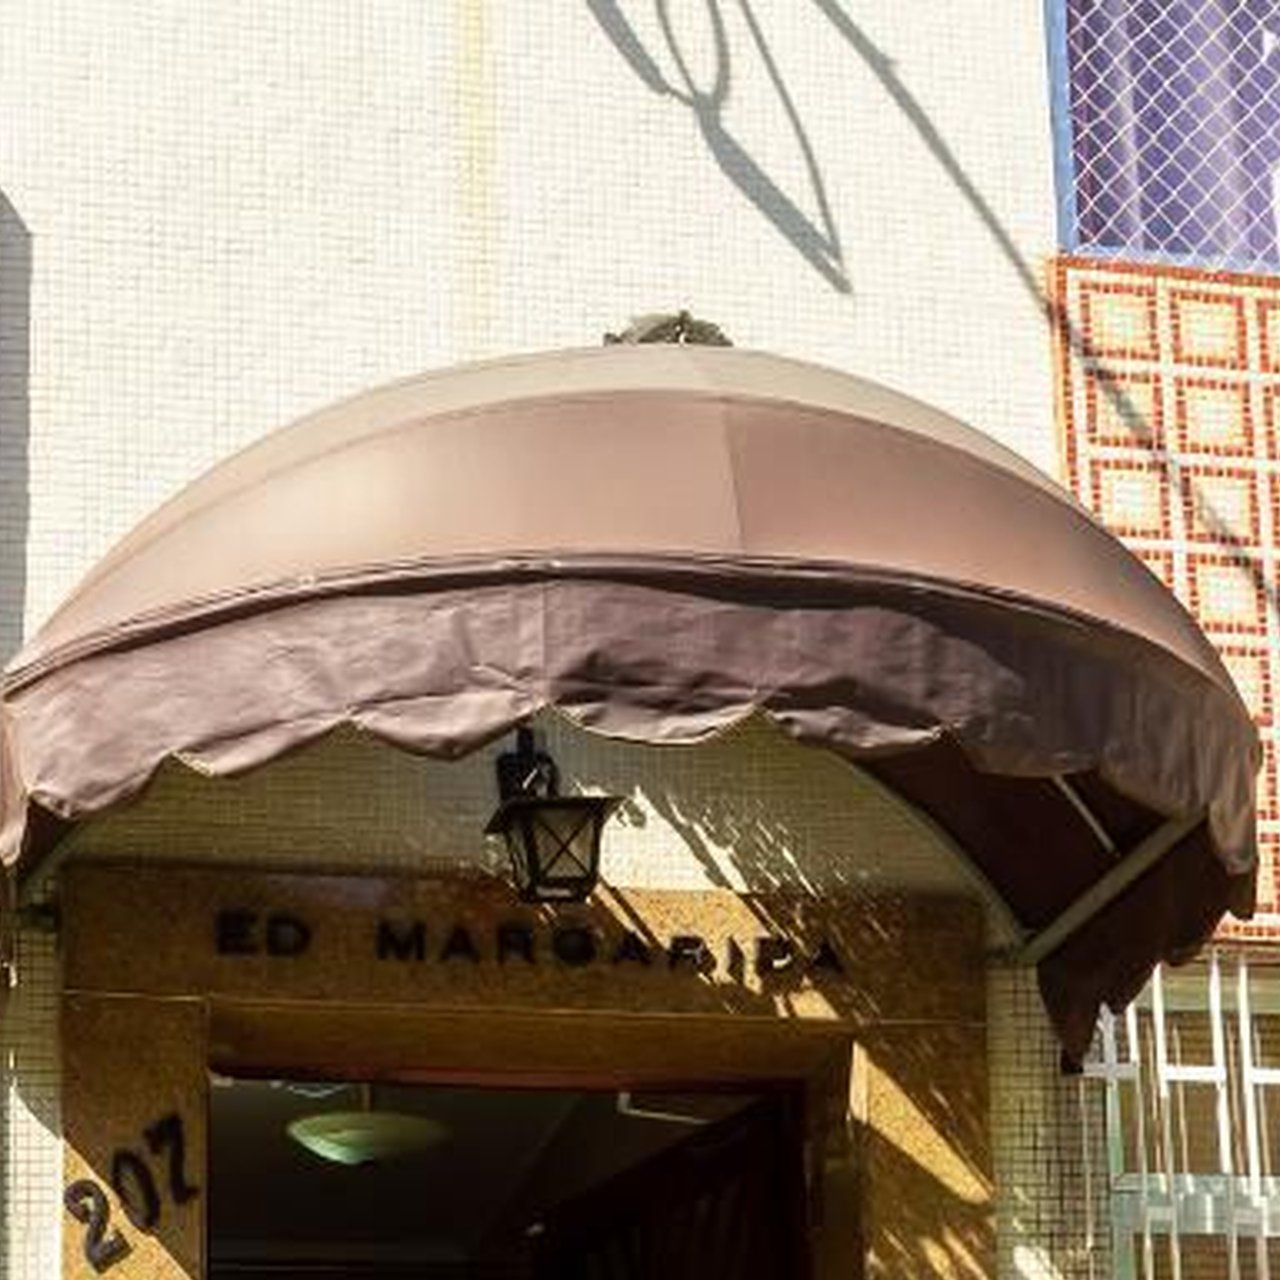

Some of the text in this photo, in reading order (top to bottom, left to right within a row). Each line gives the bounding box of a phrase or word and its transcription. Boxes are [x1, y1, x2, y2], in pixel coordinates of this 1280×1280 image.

[213, 910, 845, 974] ED MARGARIDA
[62, 1113, 199, 1275] 207
